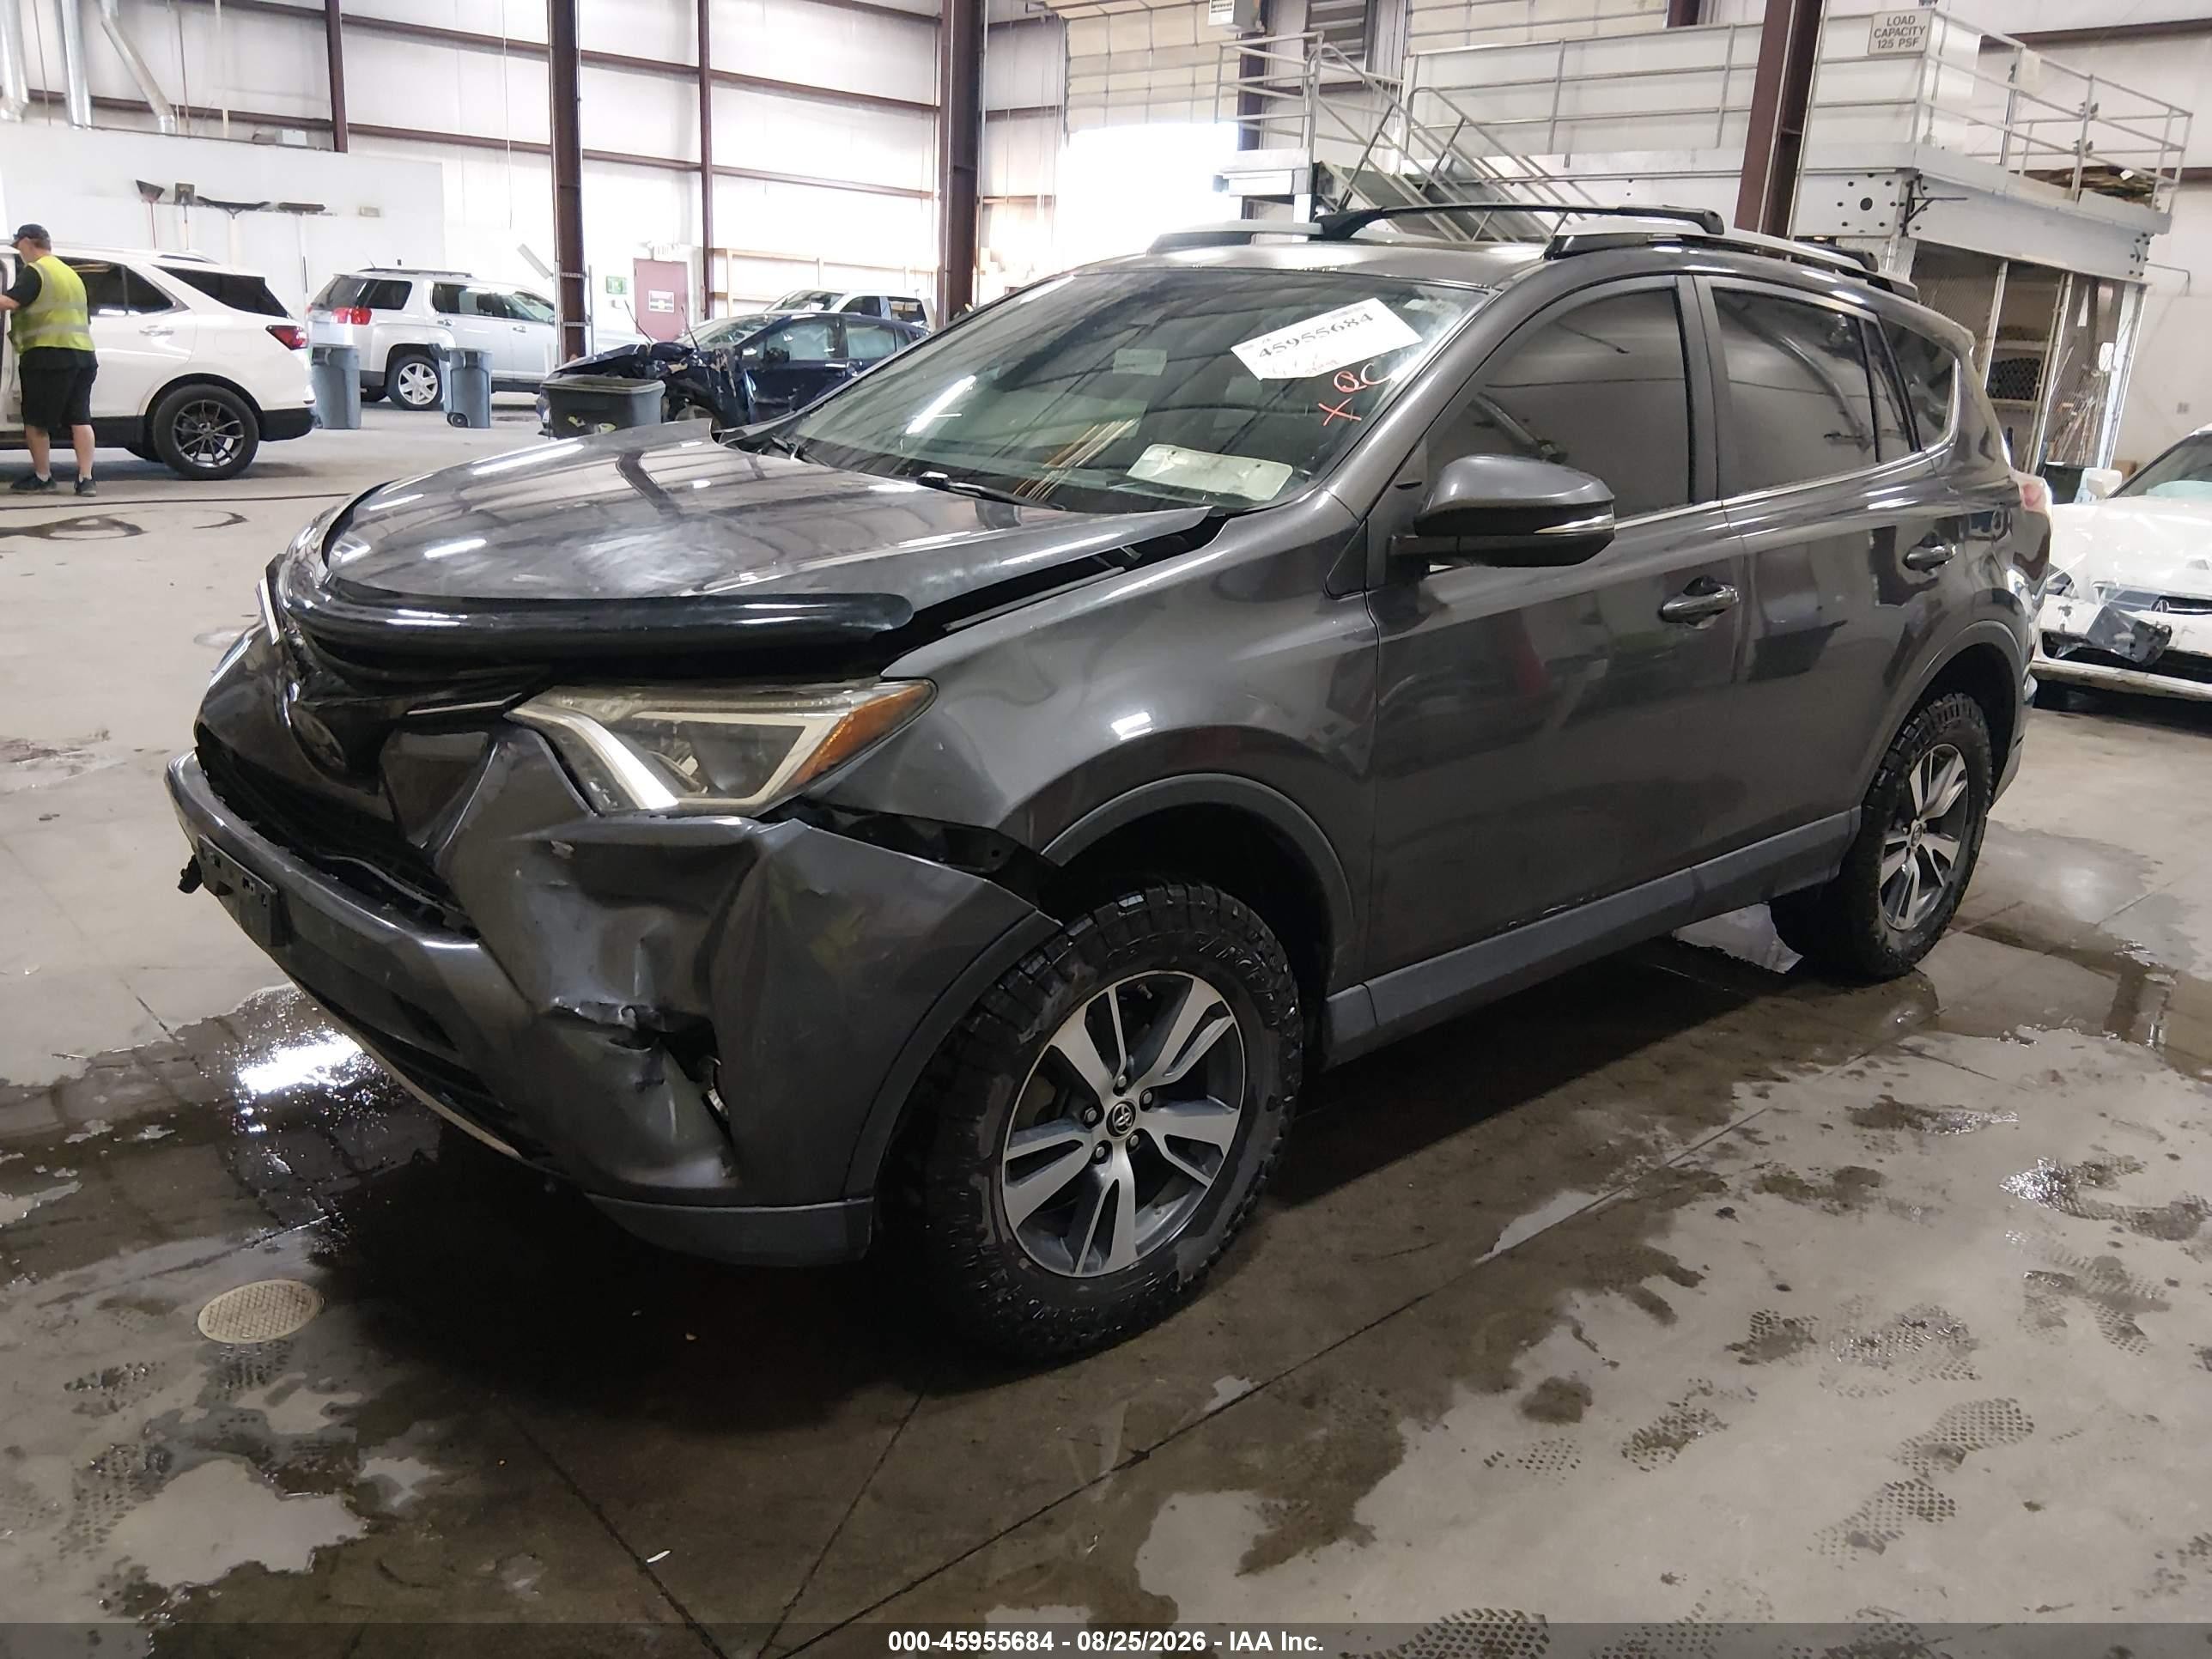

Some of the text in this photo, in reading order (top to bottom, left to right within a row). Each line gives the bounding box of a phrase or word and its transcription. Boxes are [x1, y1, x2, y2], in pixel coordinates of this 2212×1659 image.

[1887, 15, 1916, 27] LOAD
[1874, 25, 1926, 39] CAPACITY
[1877, 37, 1920, 49] 125 PSF
[1259, 313, 1374, 358] 45955684
[1333, 362, 1392, 393] QC
